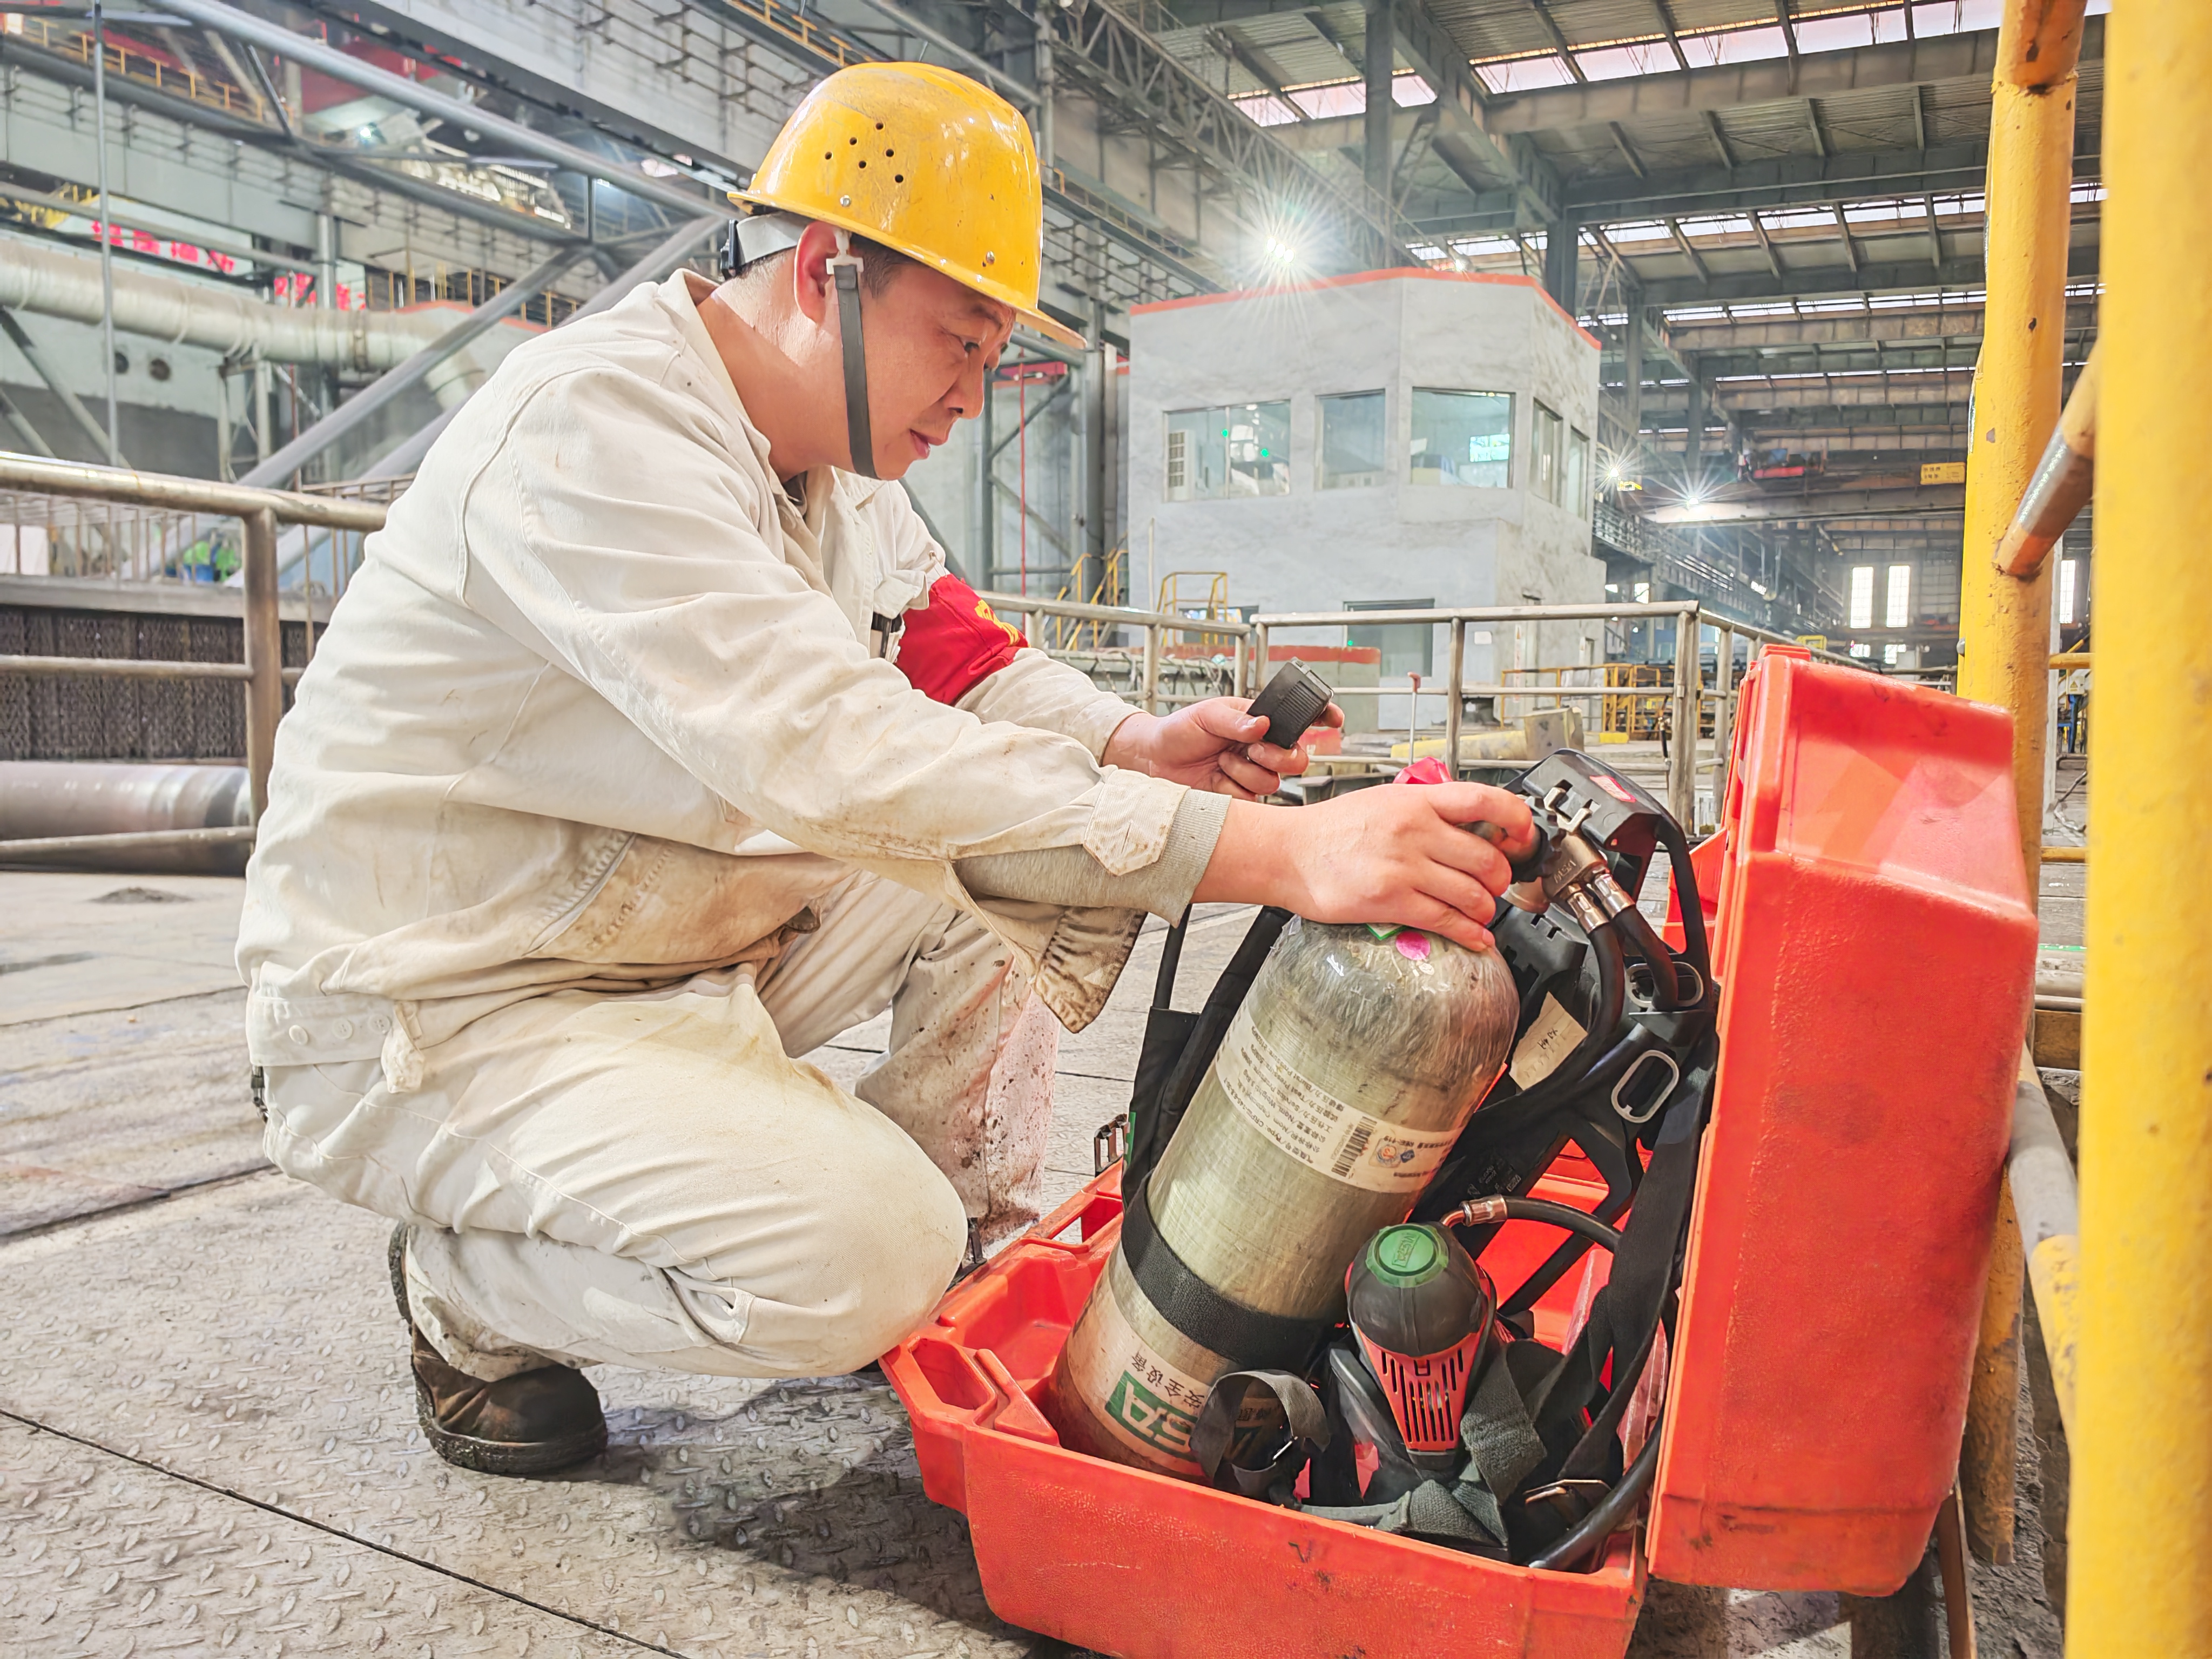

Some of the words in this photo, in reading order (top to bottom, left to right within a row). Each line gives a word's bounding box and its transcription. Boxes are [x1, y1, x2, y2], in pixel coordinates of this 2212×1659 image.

[1131, 1351, 1204, 1408] 安全设备
[1121, 1380, 1195, 1451] SA
